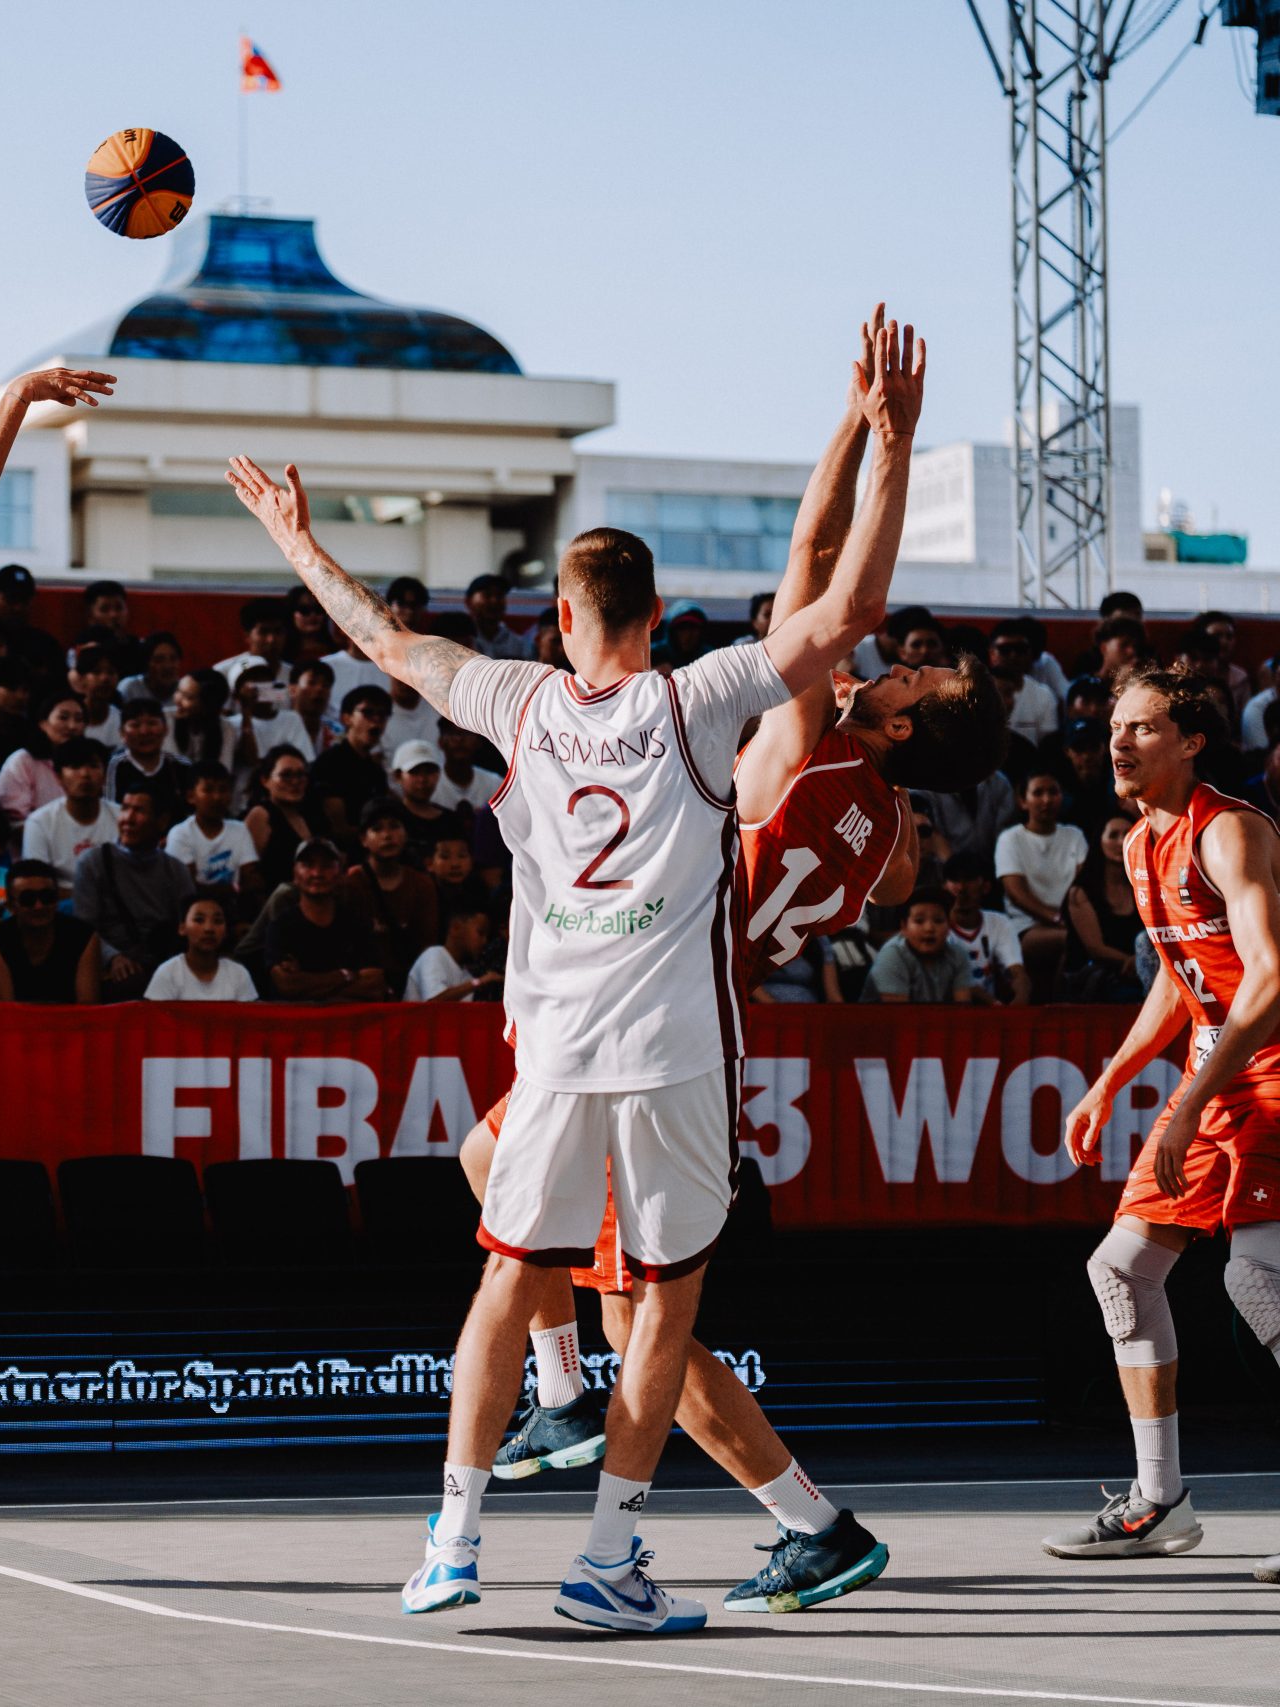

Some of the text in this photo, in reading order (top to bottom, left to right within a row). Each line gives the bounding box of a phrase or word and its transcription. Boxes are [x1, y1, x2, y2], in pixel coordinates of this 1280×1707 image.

[529, 726, 666, 767] LASMANIS
[567, 785, 634, 890] 2
[544, 903, 653, 935] Herbalife
[1173, 957, 1217, 1004] 12
[141, 1056, 479, 1187] FIBA
